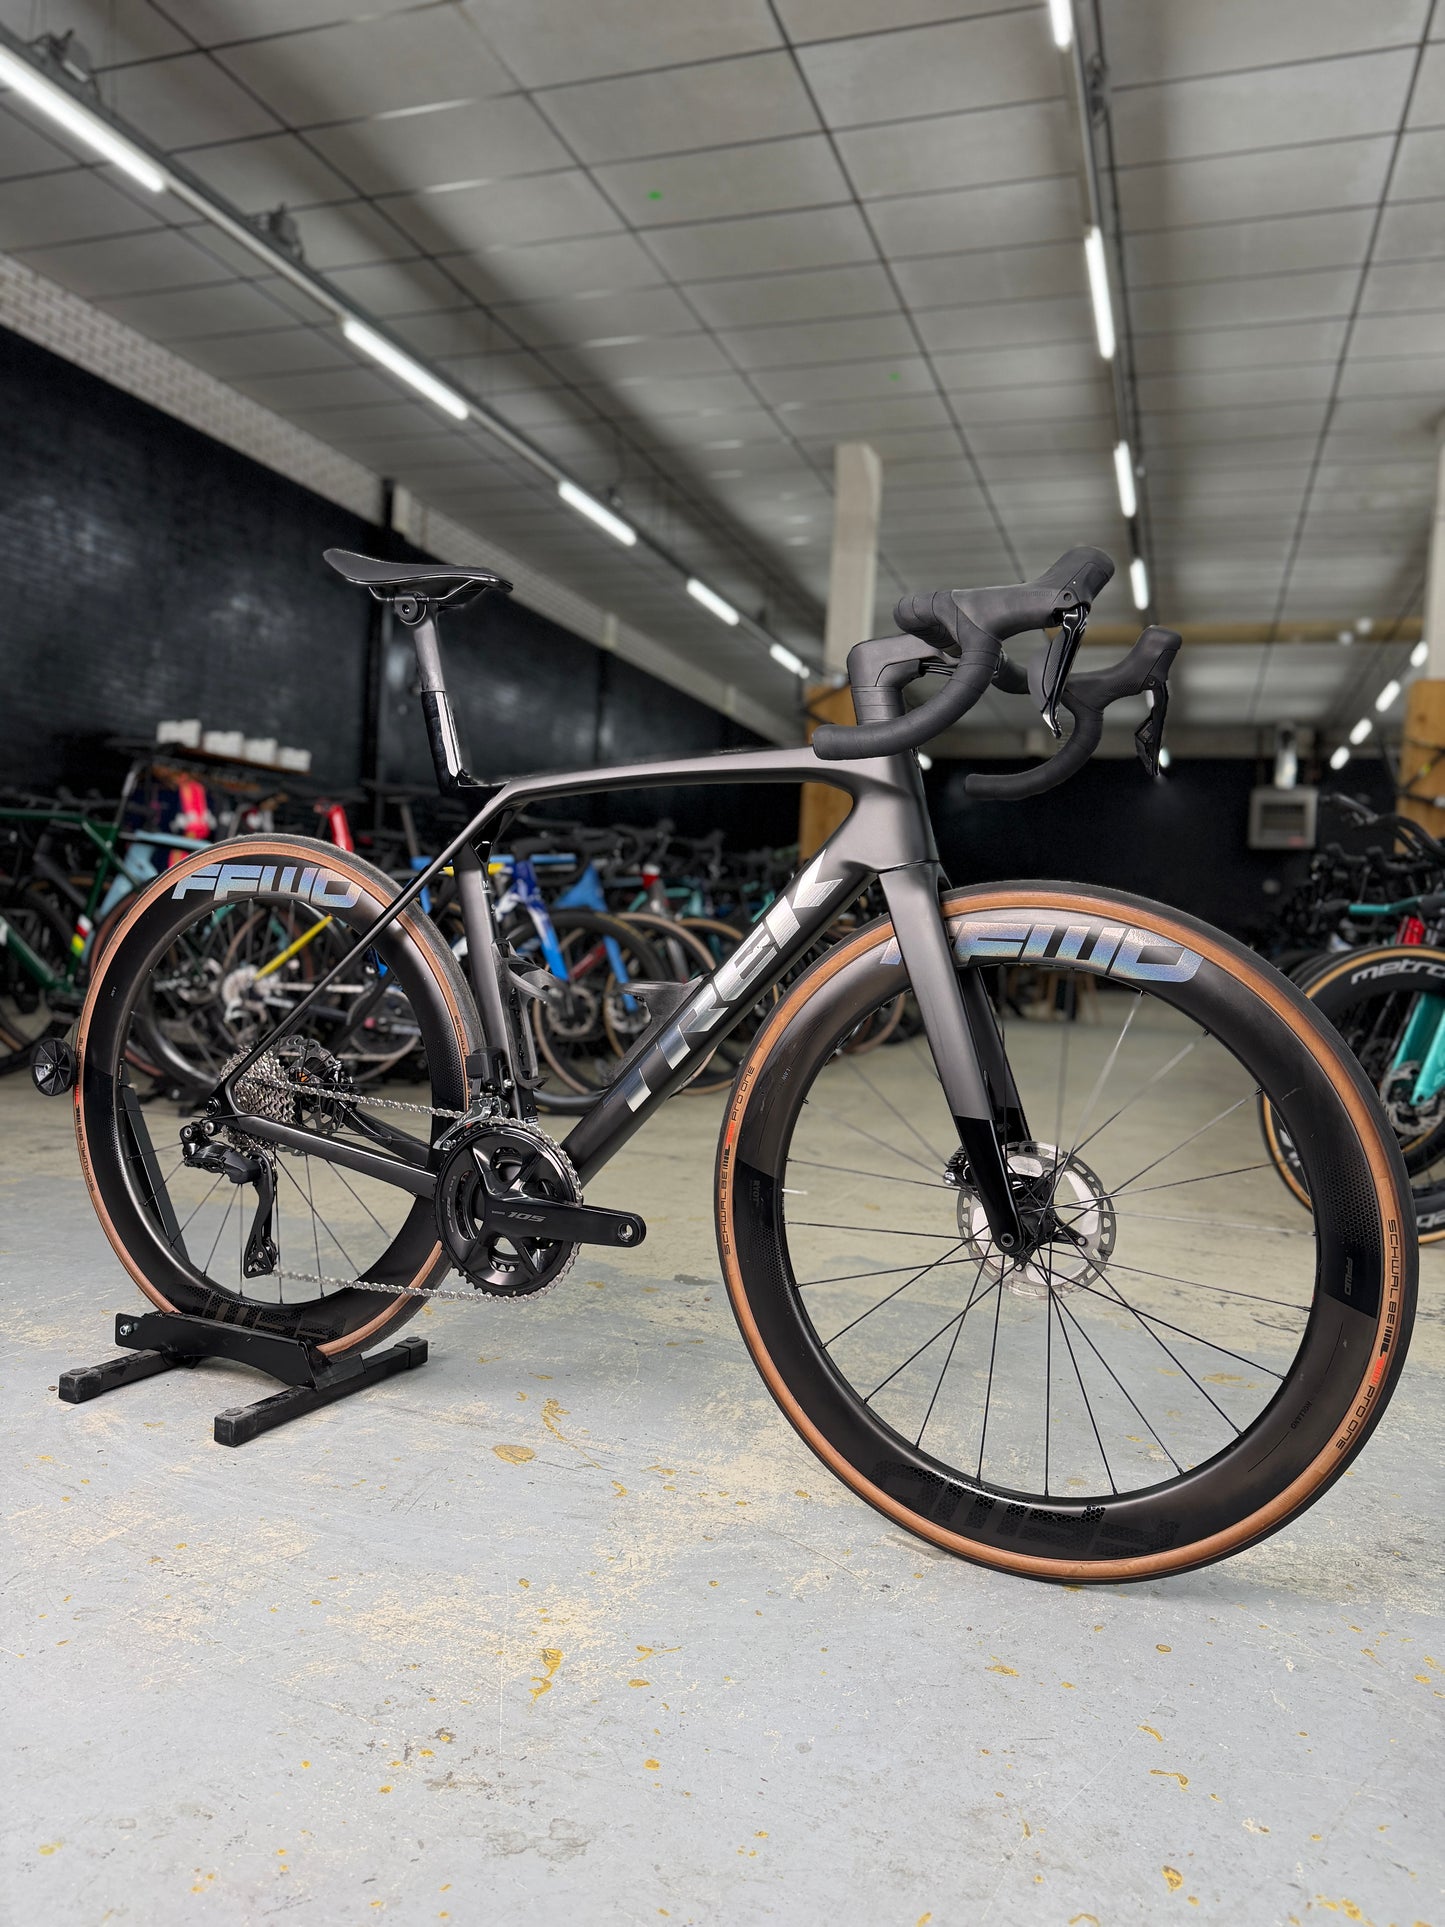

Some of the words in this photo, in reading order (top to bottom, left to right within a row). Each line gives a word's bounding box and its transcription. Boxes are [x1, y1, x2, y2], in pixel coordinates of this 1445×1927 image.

[172, 863, 364, 908] FFWD
[602, 849, 843, 1113] TREK
[507, 1211, 547, 1223] 105
[719, 1171, 731, 1256] SCHWALBE
[1386, 1219, 1402, 1326] SCHWALBE
